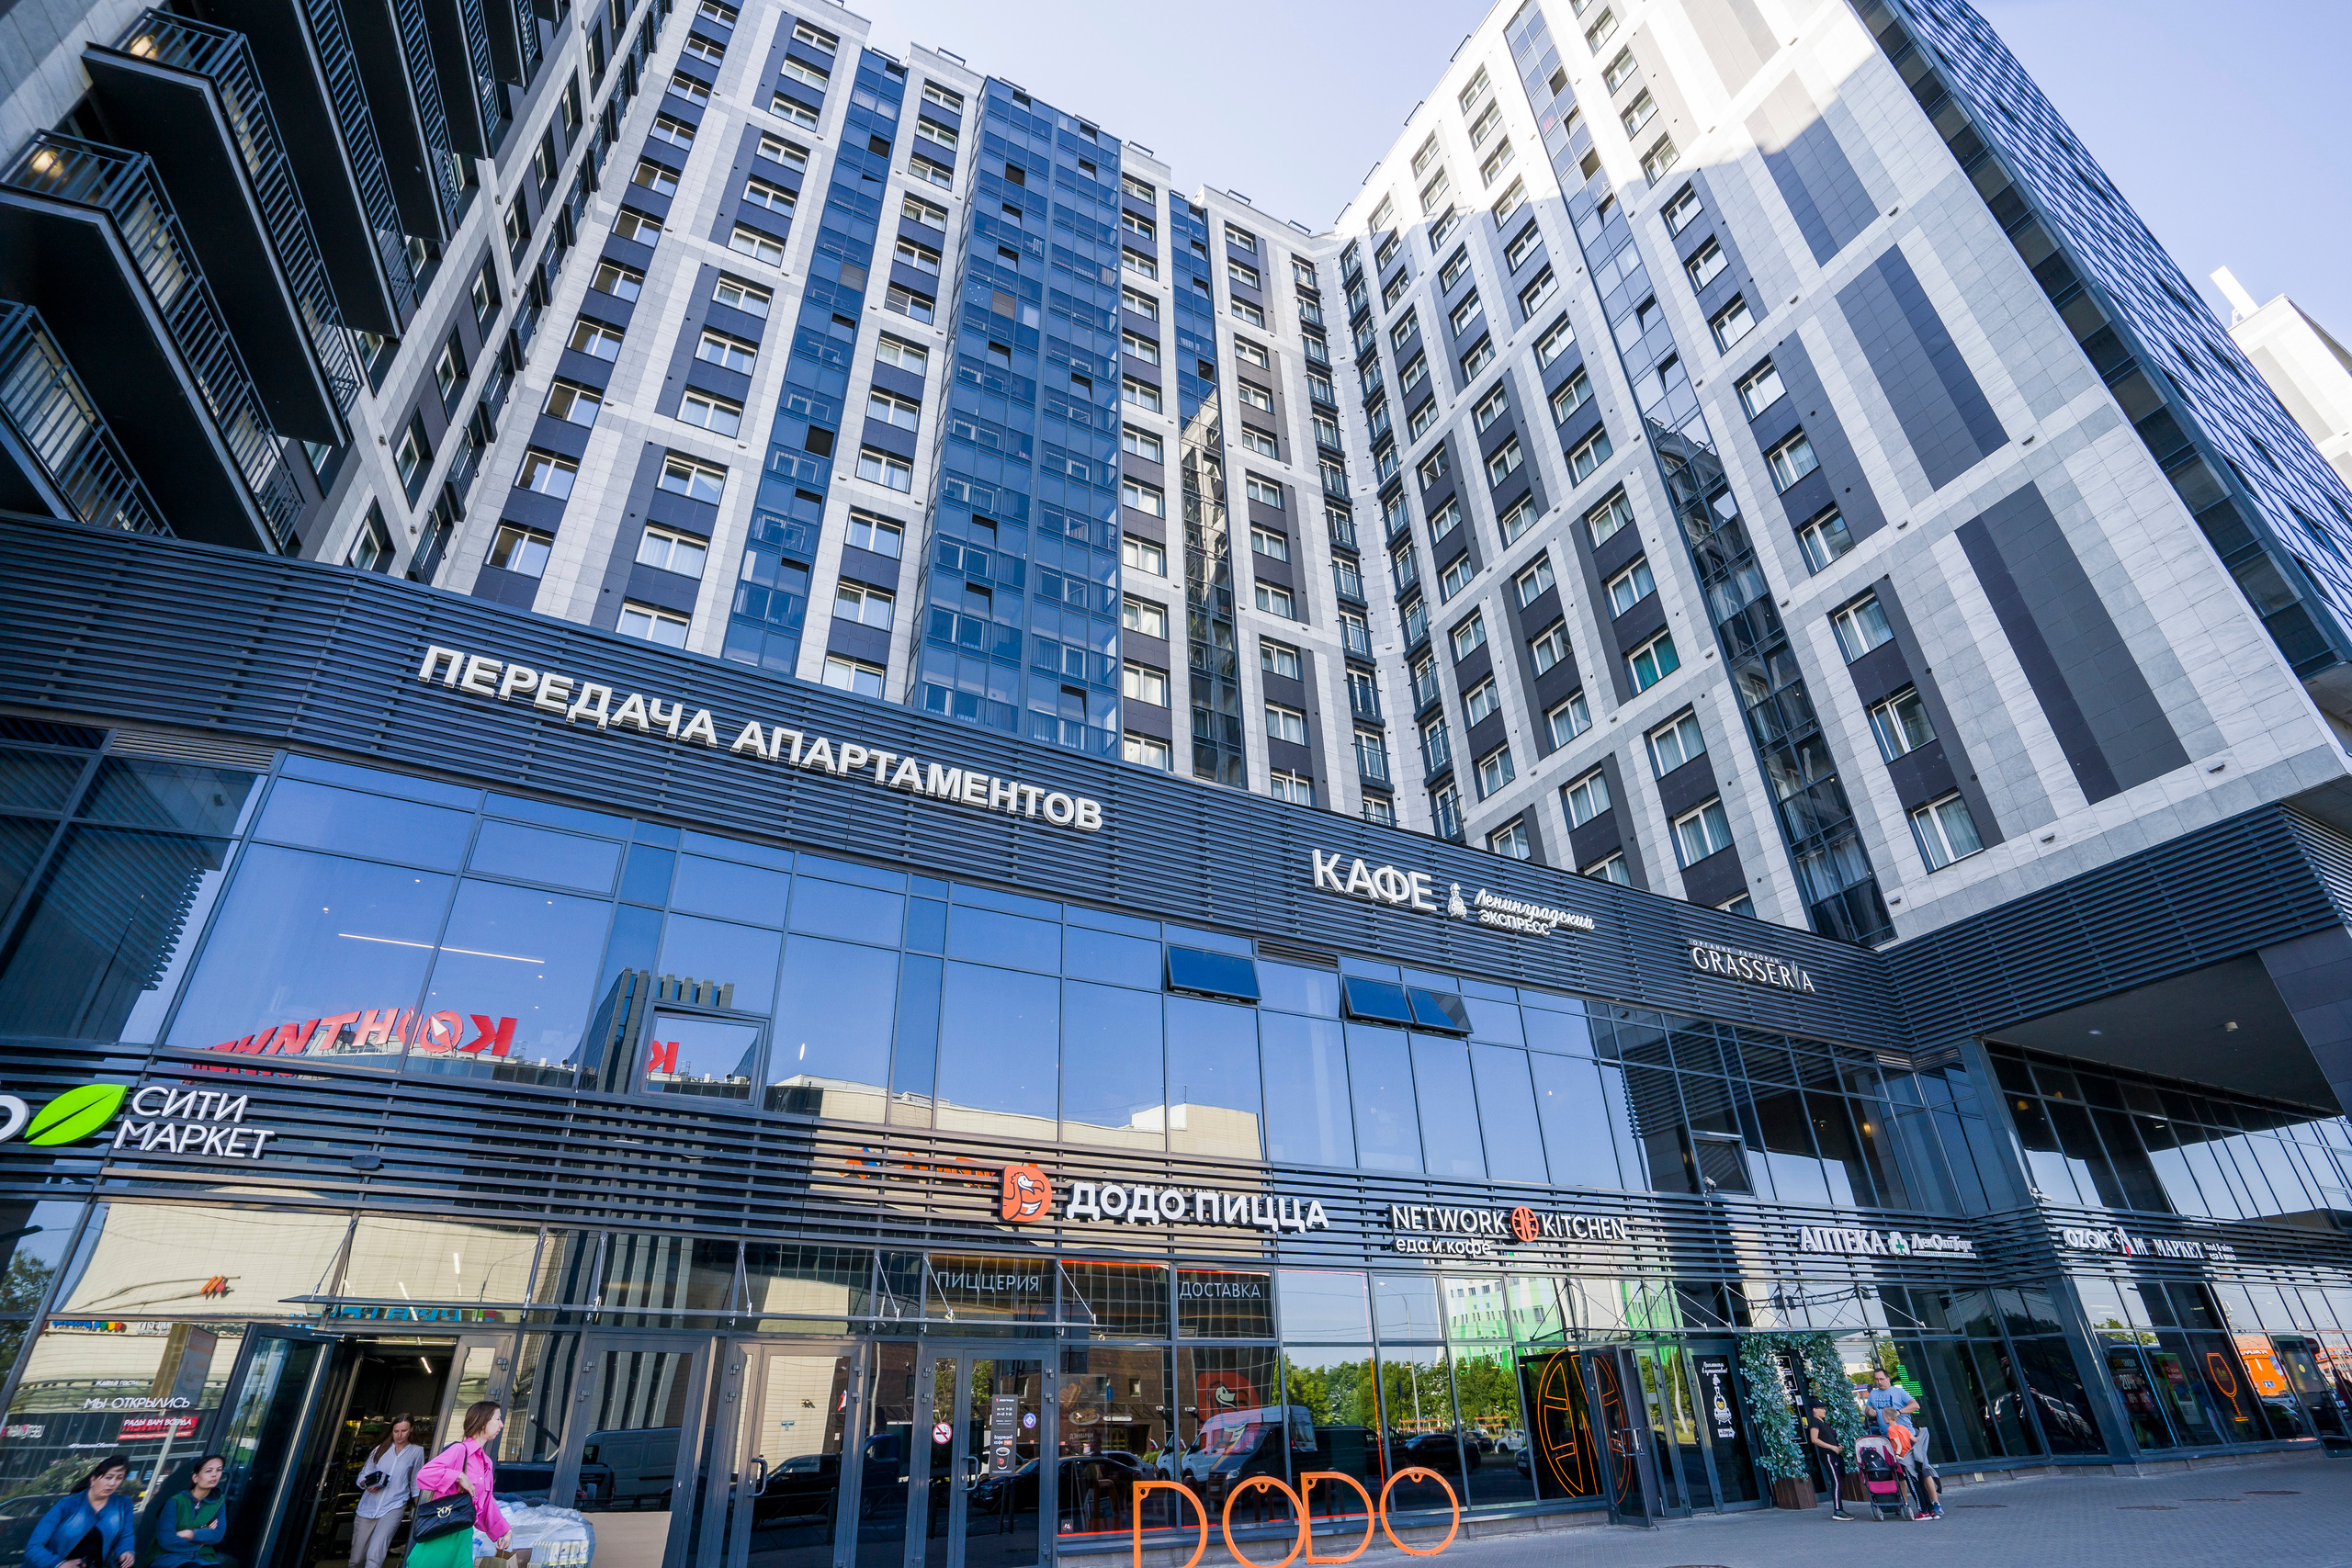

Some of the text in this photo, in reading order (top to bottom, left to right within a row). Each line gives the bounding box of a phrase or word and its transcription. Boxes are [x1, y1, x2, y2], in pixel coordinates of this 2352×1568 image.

[418, 644, 1104, 833] ПЕРЕДАЧА АПАРТАМЕНТОВ
[1312, 848, 1438, 913] КАФЕ
[1477, 908, 1551, 936] ЭКСПРЕСС
[1692, 939, 1780, 964] ОРГАНИК РЕСТОРАН
[131, 1086, 249, 1123] СИТИ
[113, 1119, 276, 1159] МАРКЕТ
[1066, 1182, 1330, 1234] ДОДО ПИЦЦА
[1391, 1204, 1509, 1235] NETWORK
[1542, 1214, 1627, 1241] KITCHEN
[1396, 1237, 1491, 1258] еда и кофе
[1800, 1225, 1888, 1255] АПТЕКА
[2063, 1228, 2113, 1250] OZON
[2153, 1238, 2205, 1259] МАРКЕТ
[936, 1271, 1039, 1293] ПИЦЦЕРИЯ
[1179, 1281, 1261, 1299] ДОСТАВКА
[83, 1396, 191, 1409] МЫ ОТКРЫЛИСЬ
